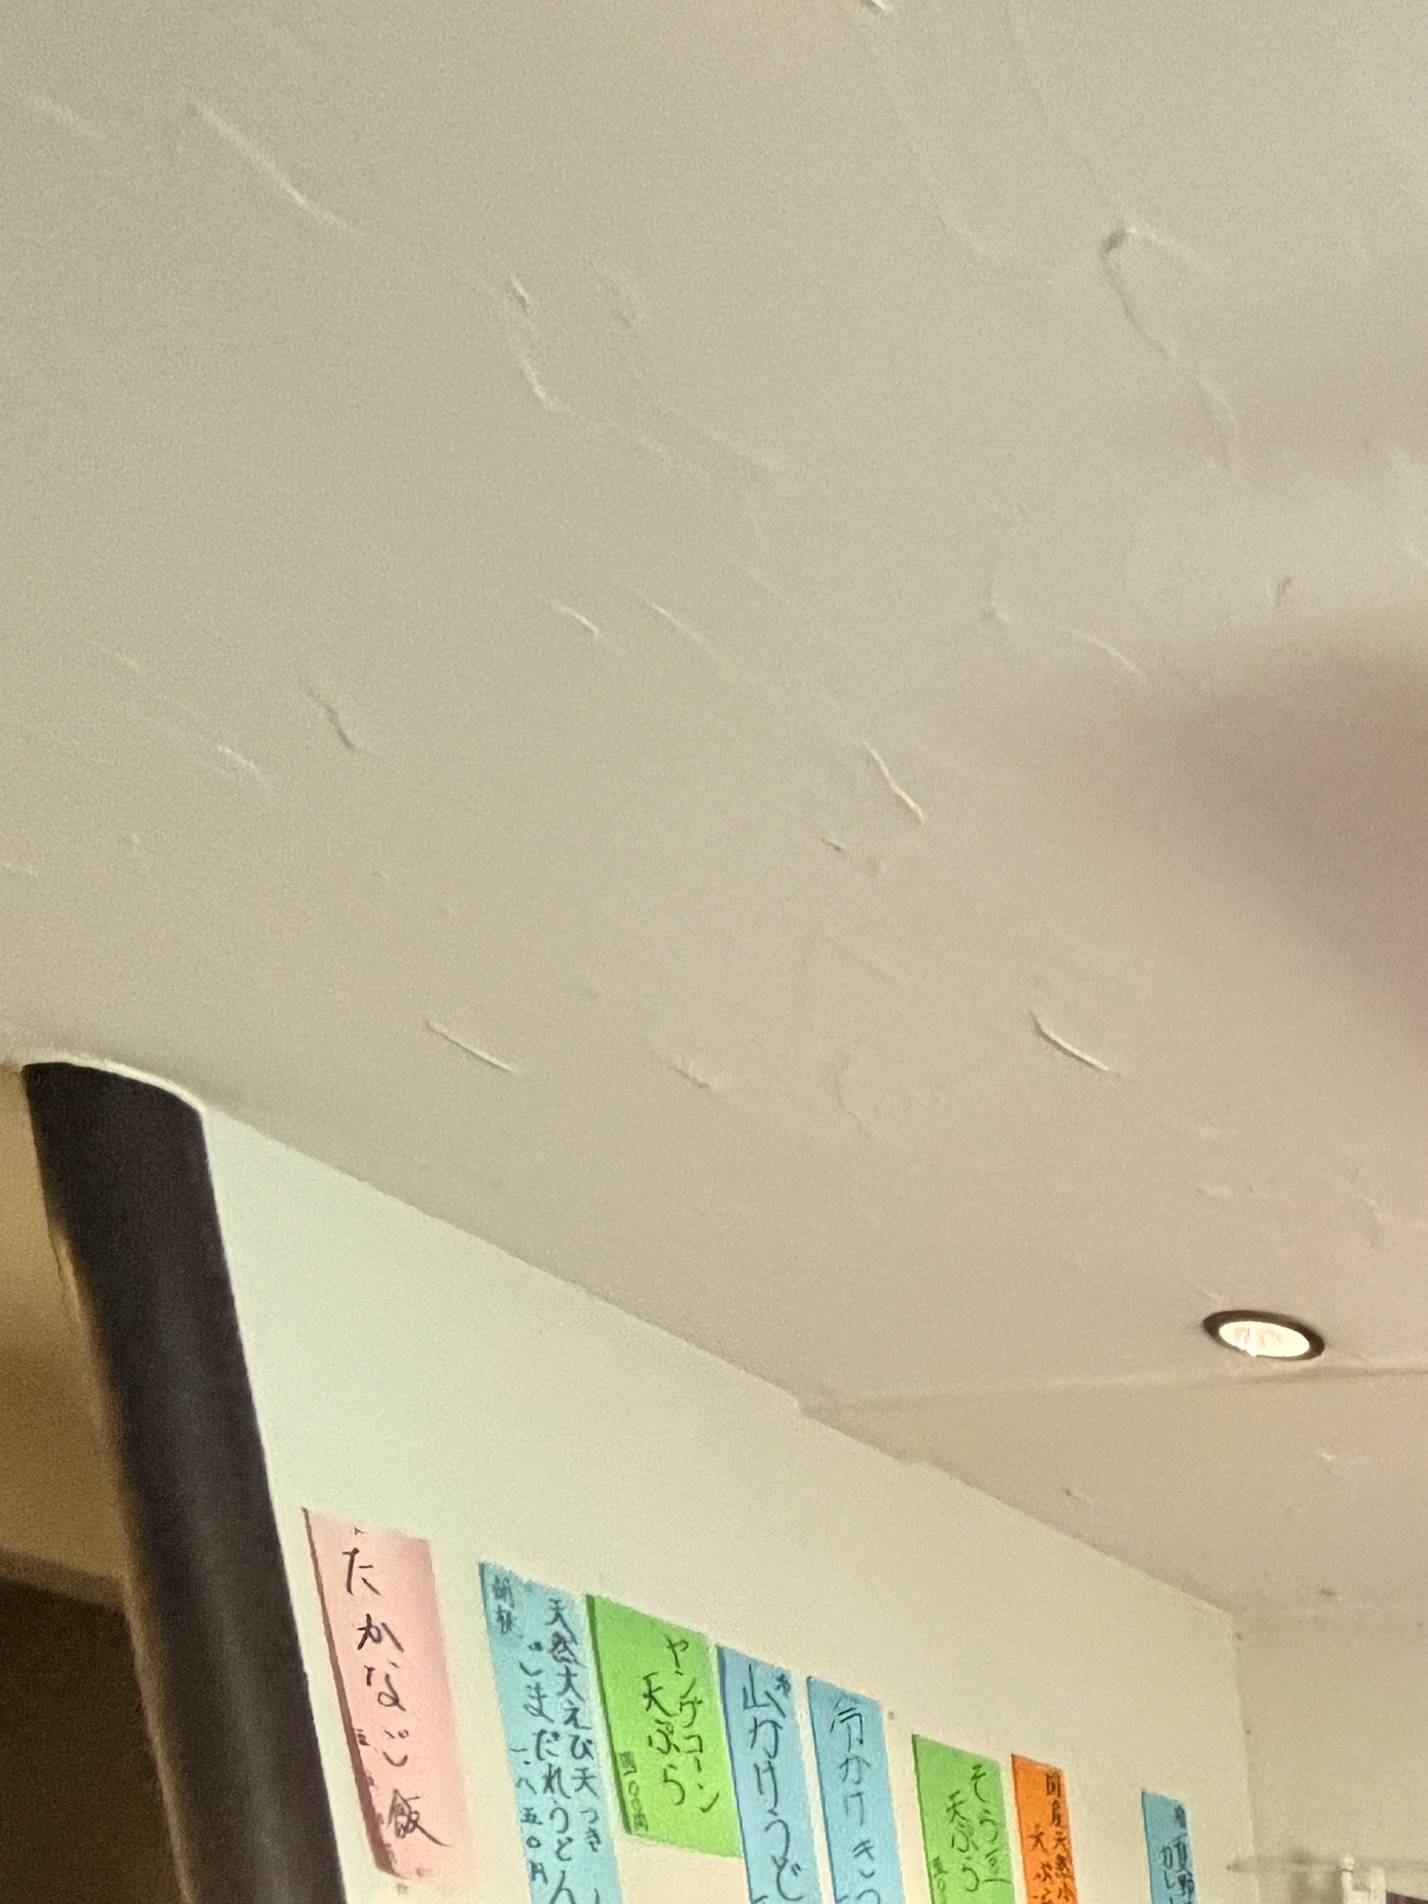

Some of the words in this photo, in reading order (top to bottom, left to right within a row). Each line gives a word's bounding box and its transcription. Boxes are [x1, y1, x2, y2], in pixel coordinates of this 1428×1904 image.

[641, 1671, 686, 1805] 天ぷら
[664, 1633, 720, 1813] ヤングコーン
[946, 1789, 980, 1892] 天ぷら
